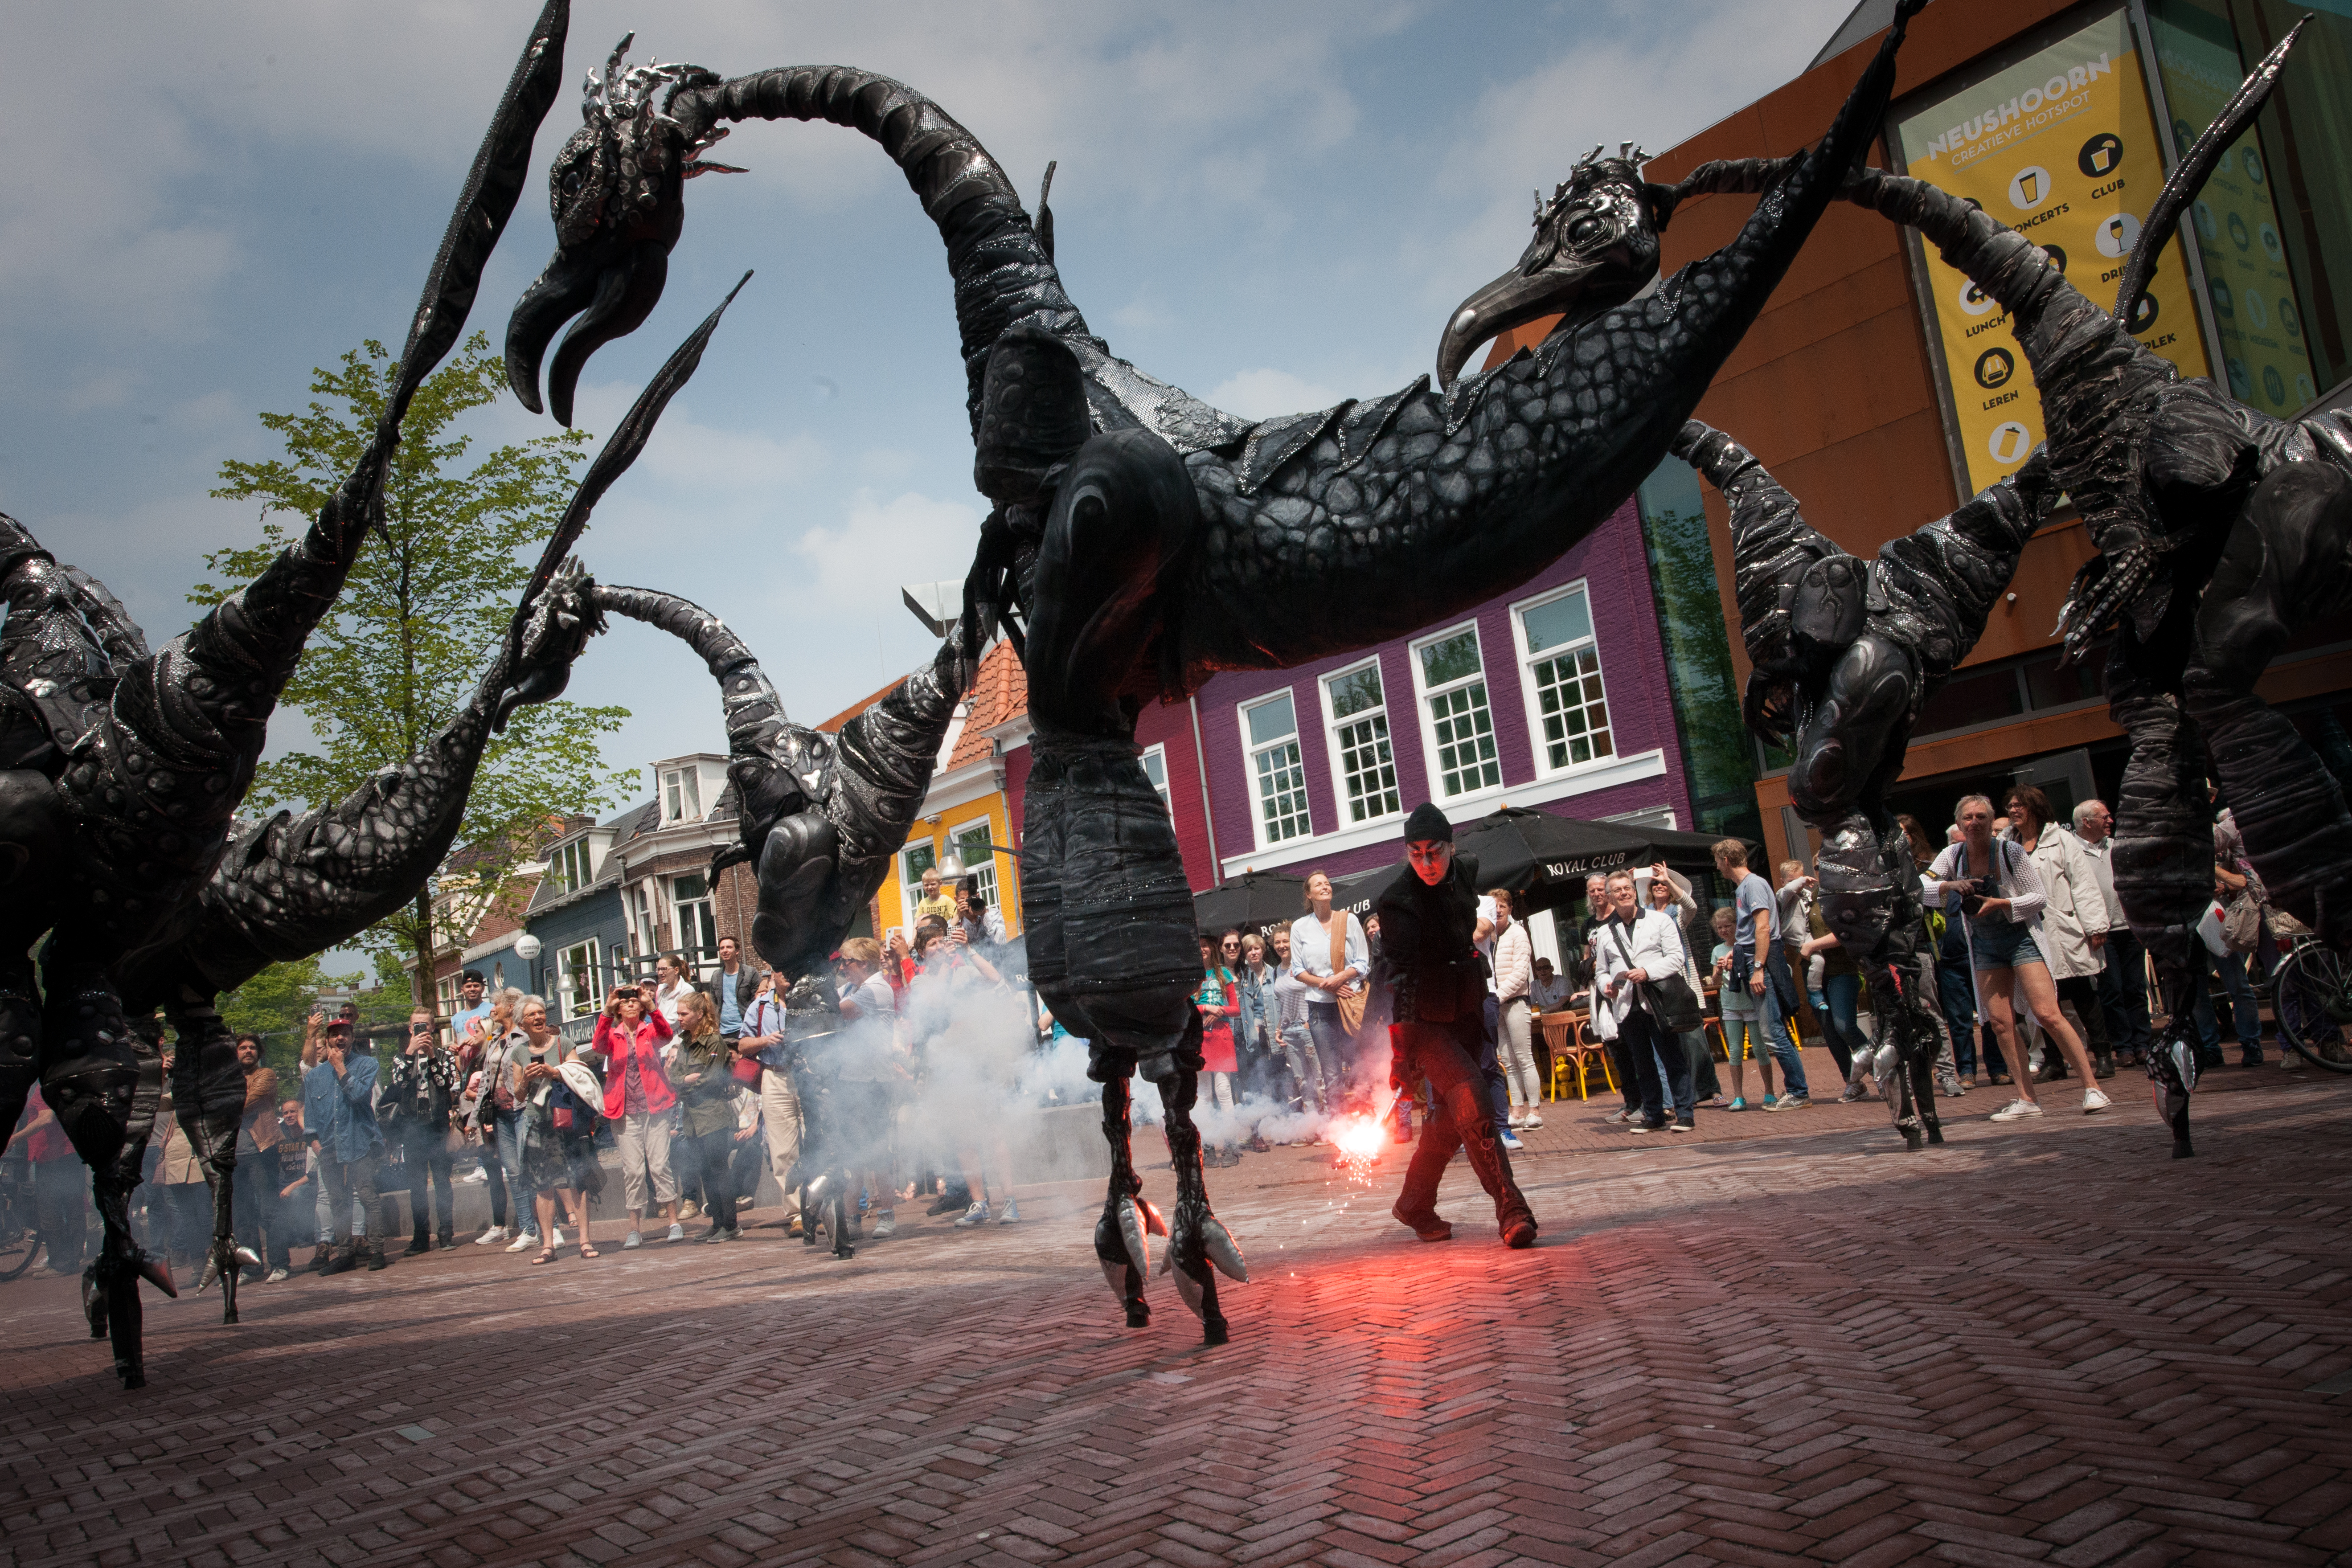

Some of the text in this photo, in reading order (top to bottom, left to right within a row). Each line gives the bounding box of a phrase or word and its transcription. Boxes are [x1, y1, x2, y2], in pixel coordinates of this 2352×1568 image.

[1927, 52, 2111, 161] NEUSHOORN
[1951, 90, 2090, 165] CREATIEVE HOTSPOT
[2091, 178, 2125, 199] CLUB
[2012, 203, 2070, 234] ONCERTS
[1965, 315, 2006, 338] LUNCH
[1982, 389, 2019, 411] LEREN
[1546, 852, 1625, 876] ROYAL CLUB
[927, 905, 947, 913] DIDN'T
